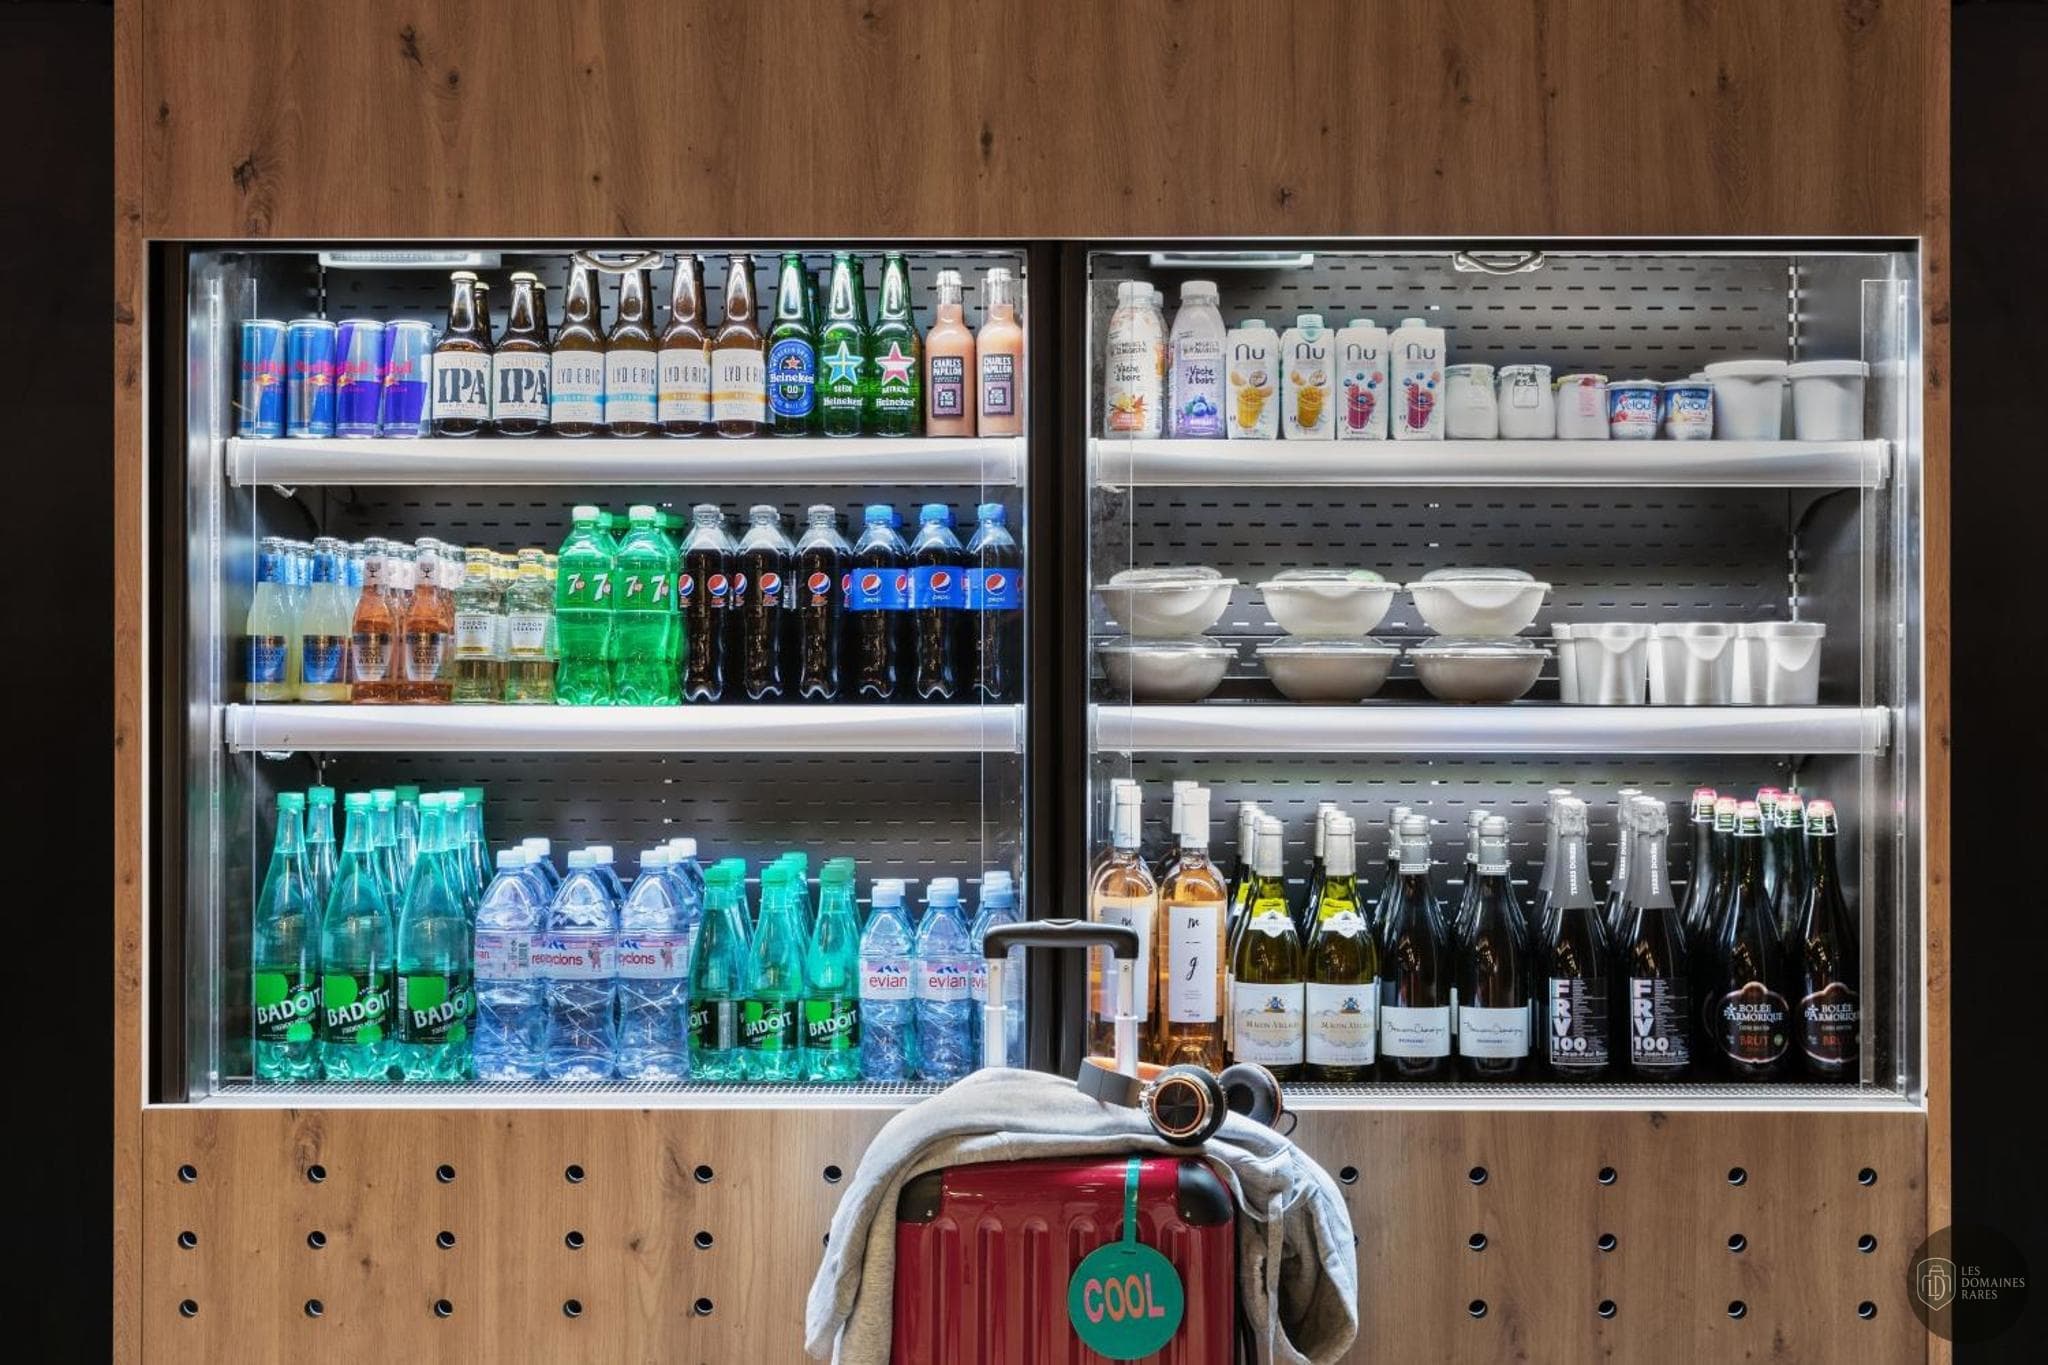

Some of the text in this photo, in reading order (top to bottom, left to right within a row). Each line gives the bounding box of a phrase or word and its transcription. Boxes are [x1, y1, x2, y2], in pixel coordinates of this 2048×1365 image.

[933, 359, 962, 368] CHARLES
[770, 372, 814, 383] Heineken
[438, 368, 487, 405] IPA
[499, 368, 548, 405] IPA
[823, 397, 863, 407] Heineken
[876, 398, 915, 408] Heineken
[869, 974, 908, 988] evian
[929, 975, 966, 988] evian
[971, 975, 986, 988] evi
[257, 987, 322, 1024] BADOIT
[327, 989, 391, 1027] BADOIT
[414, 992, 469, 1029] BADO
[1805, 1008, 1860, 1023] D'ARMORIQU
[746, 1011, 793, 1037] BADOIT
[808, 1010, 858, 1037] BADOIT
[1552, 1036, 1587, 1051] 100
[1634, 1036, 1669, 1051] 100
[1083, 1272, 1165, 1324] COOL
